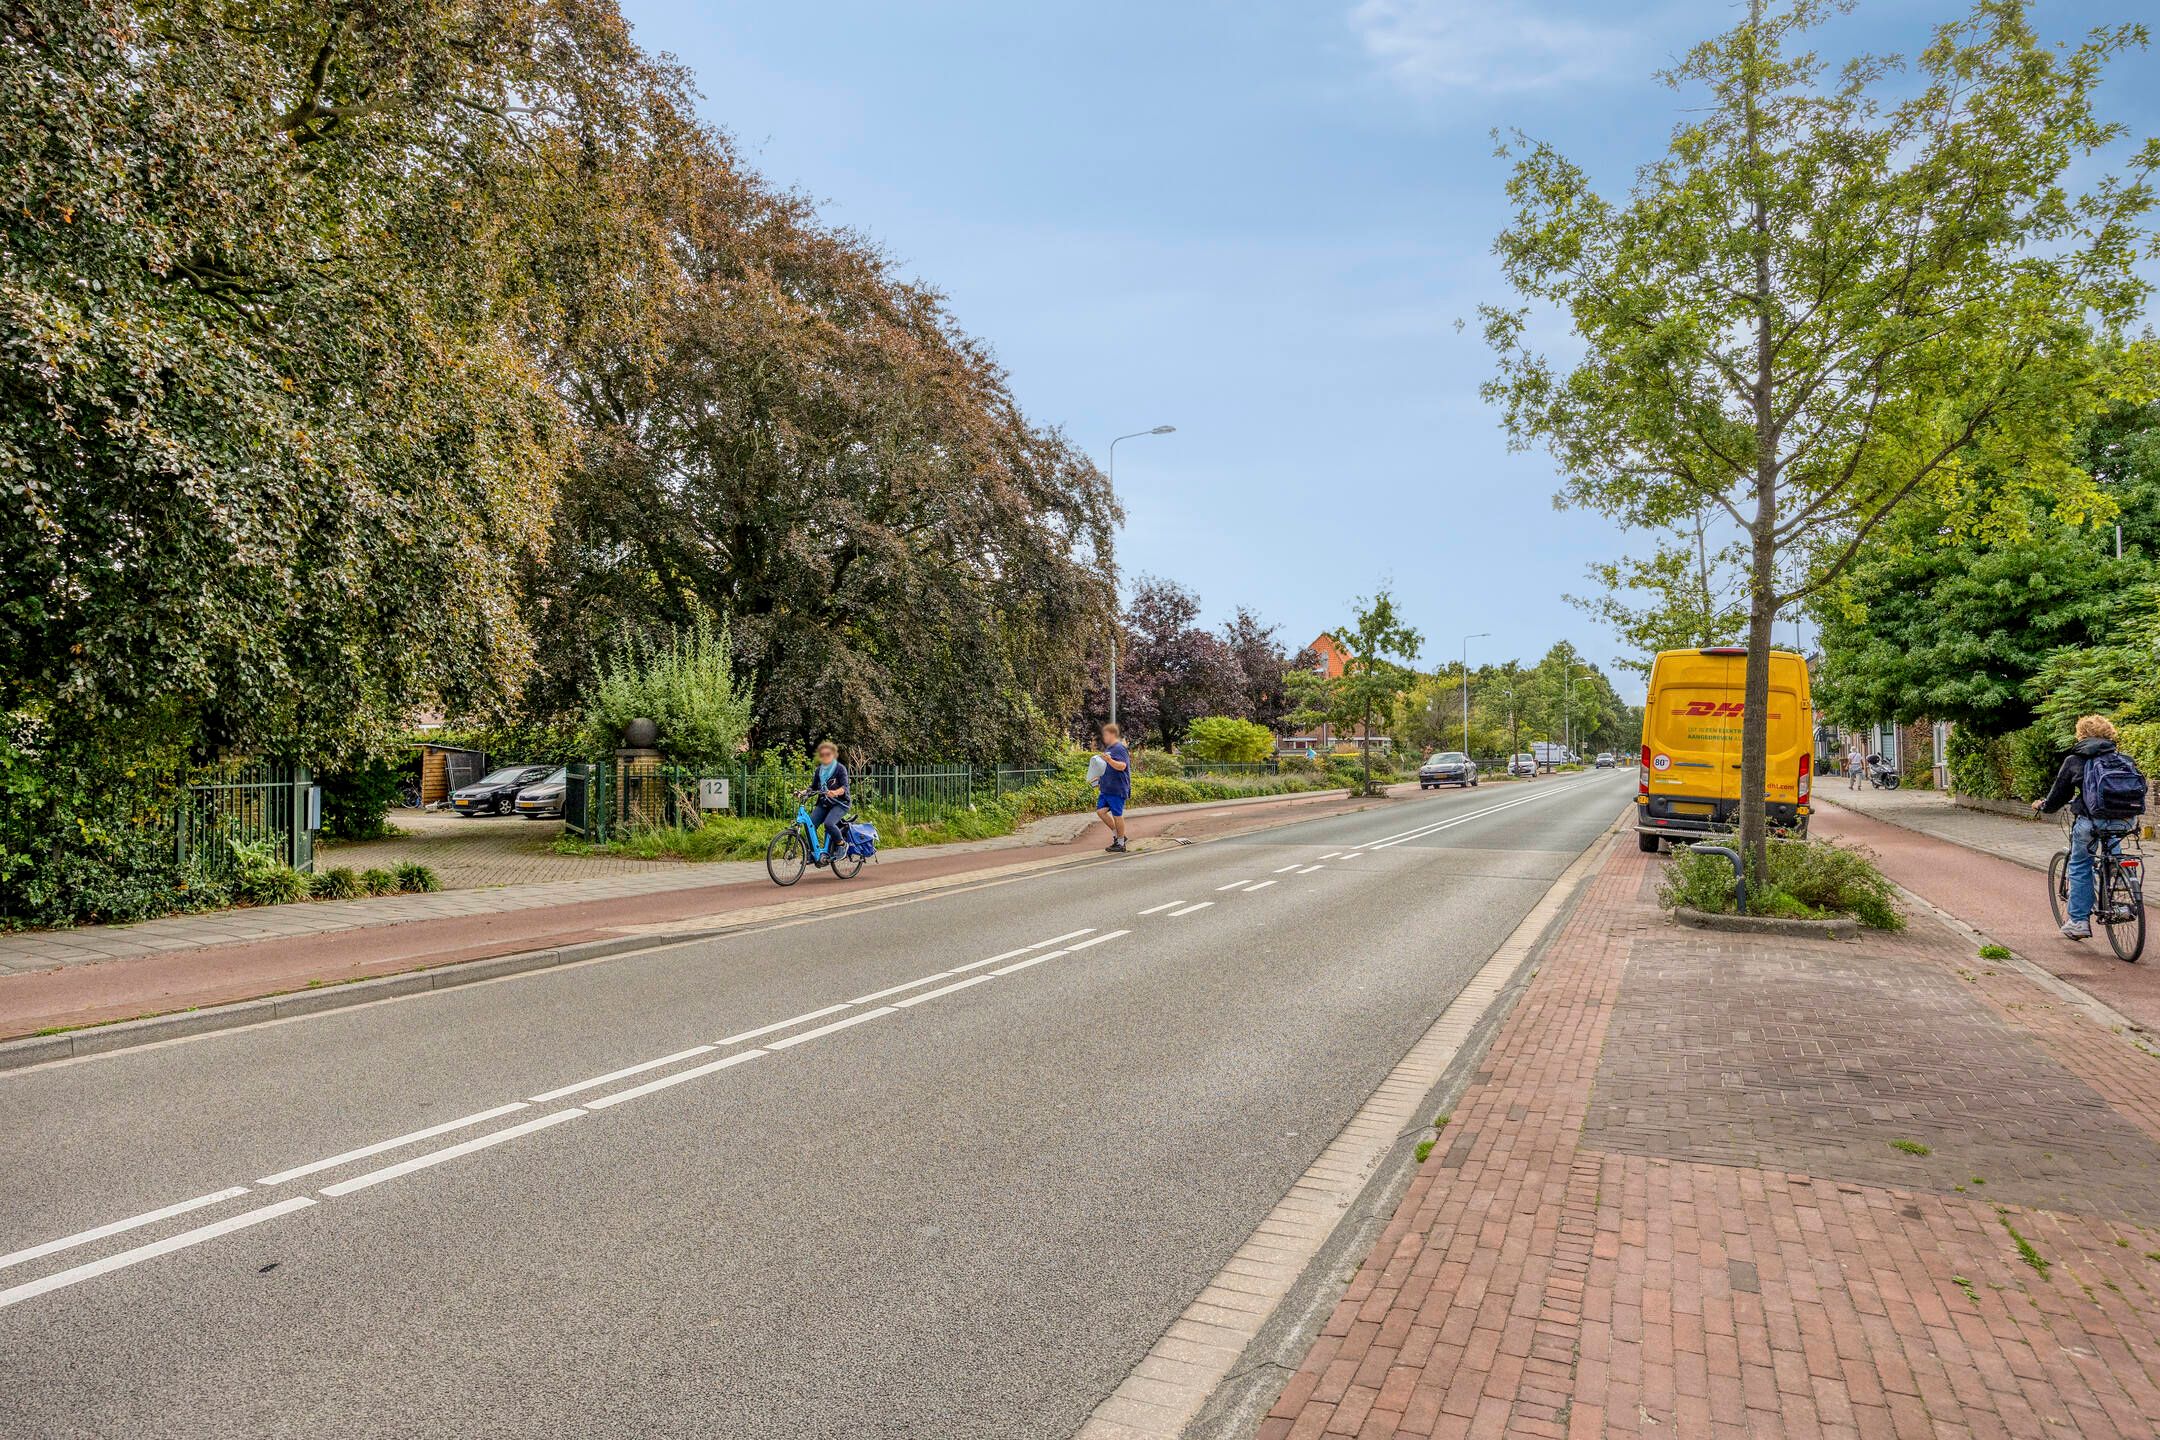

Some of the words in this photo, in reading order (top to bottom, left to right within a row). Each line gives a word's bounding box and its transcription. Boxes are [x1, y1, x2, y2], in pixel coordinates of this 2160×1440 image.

[1686, 701, 1745, 717] DH
[1655, 758, 1665, 767] 80
[705, 781, 723, 795] 12
